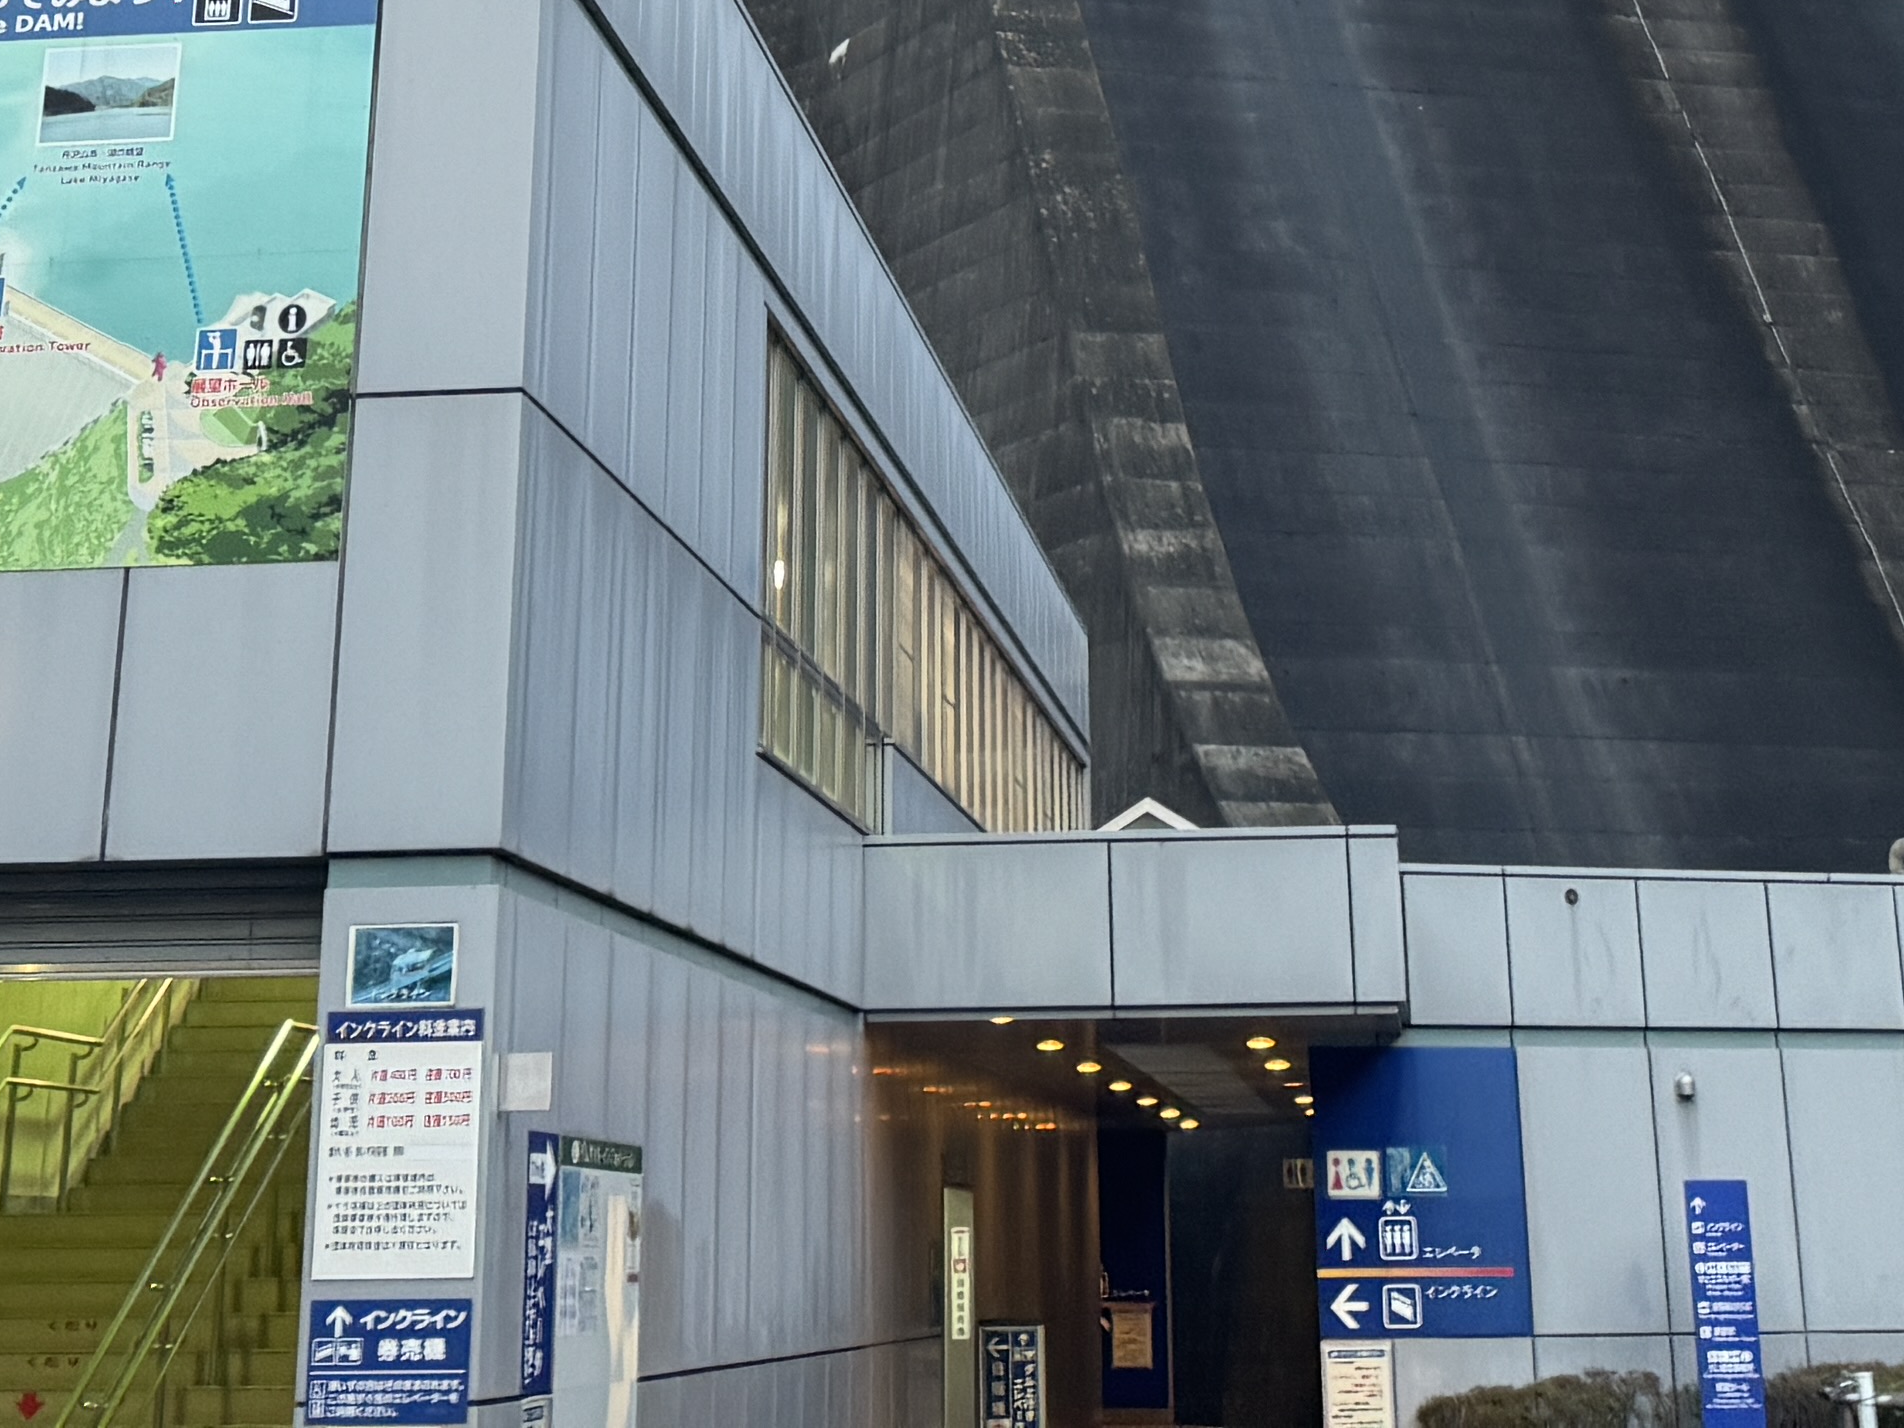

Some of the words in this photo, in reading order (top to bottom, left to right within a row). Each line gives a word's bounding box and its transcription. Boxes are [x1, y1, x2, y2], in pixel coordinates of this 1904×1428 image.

[14, 13, 84, 33] DAM!
[359, 1308, 468, 1331] インクライン
